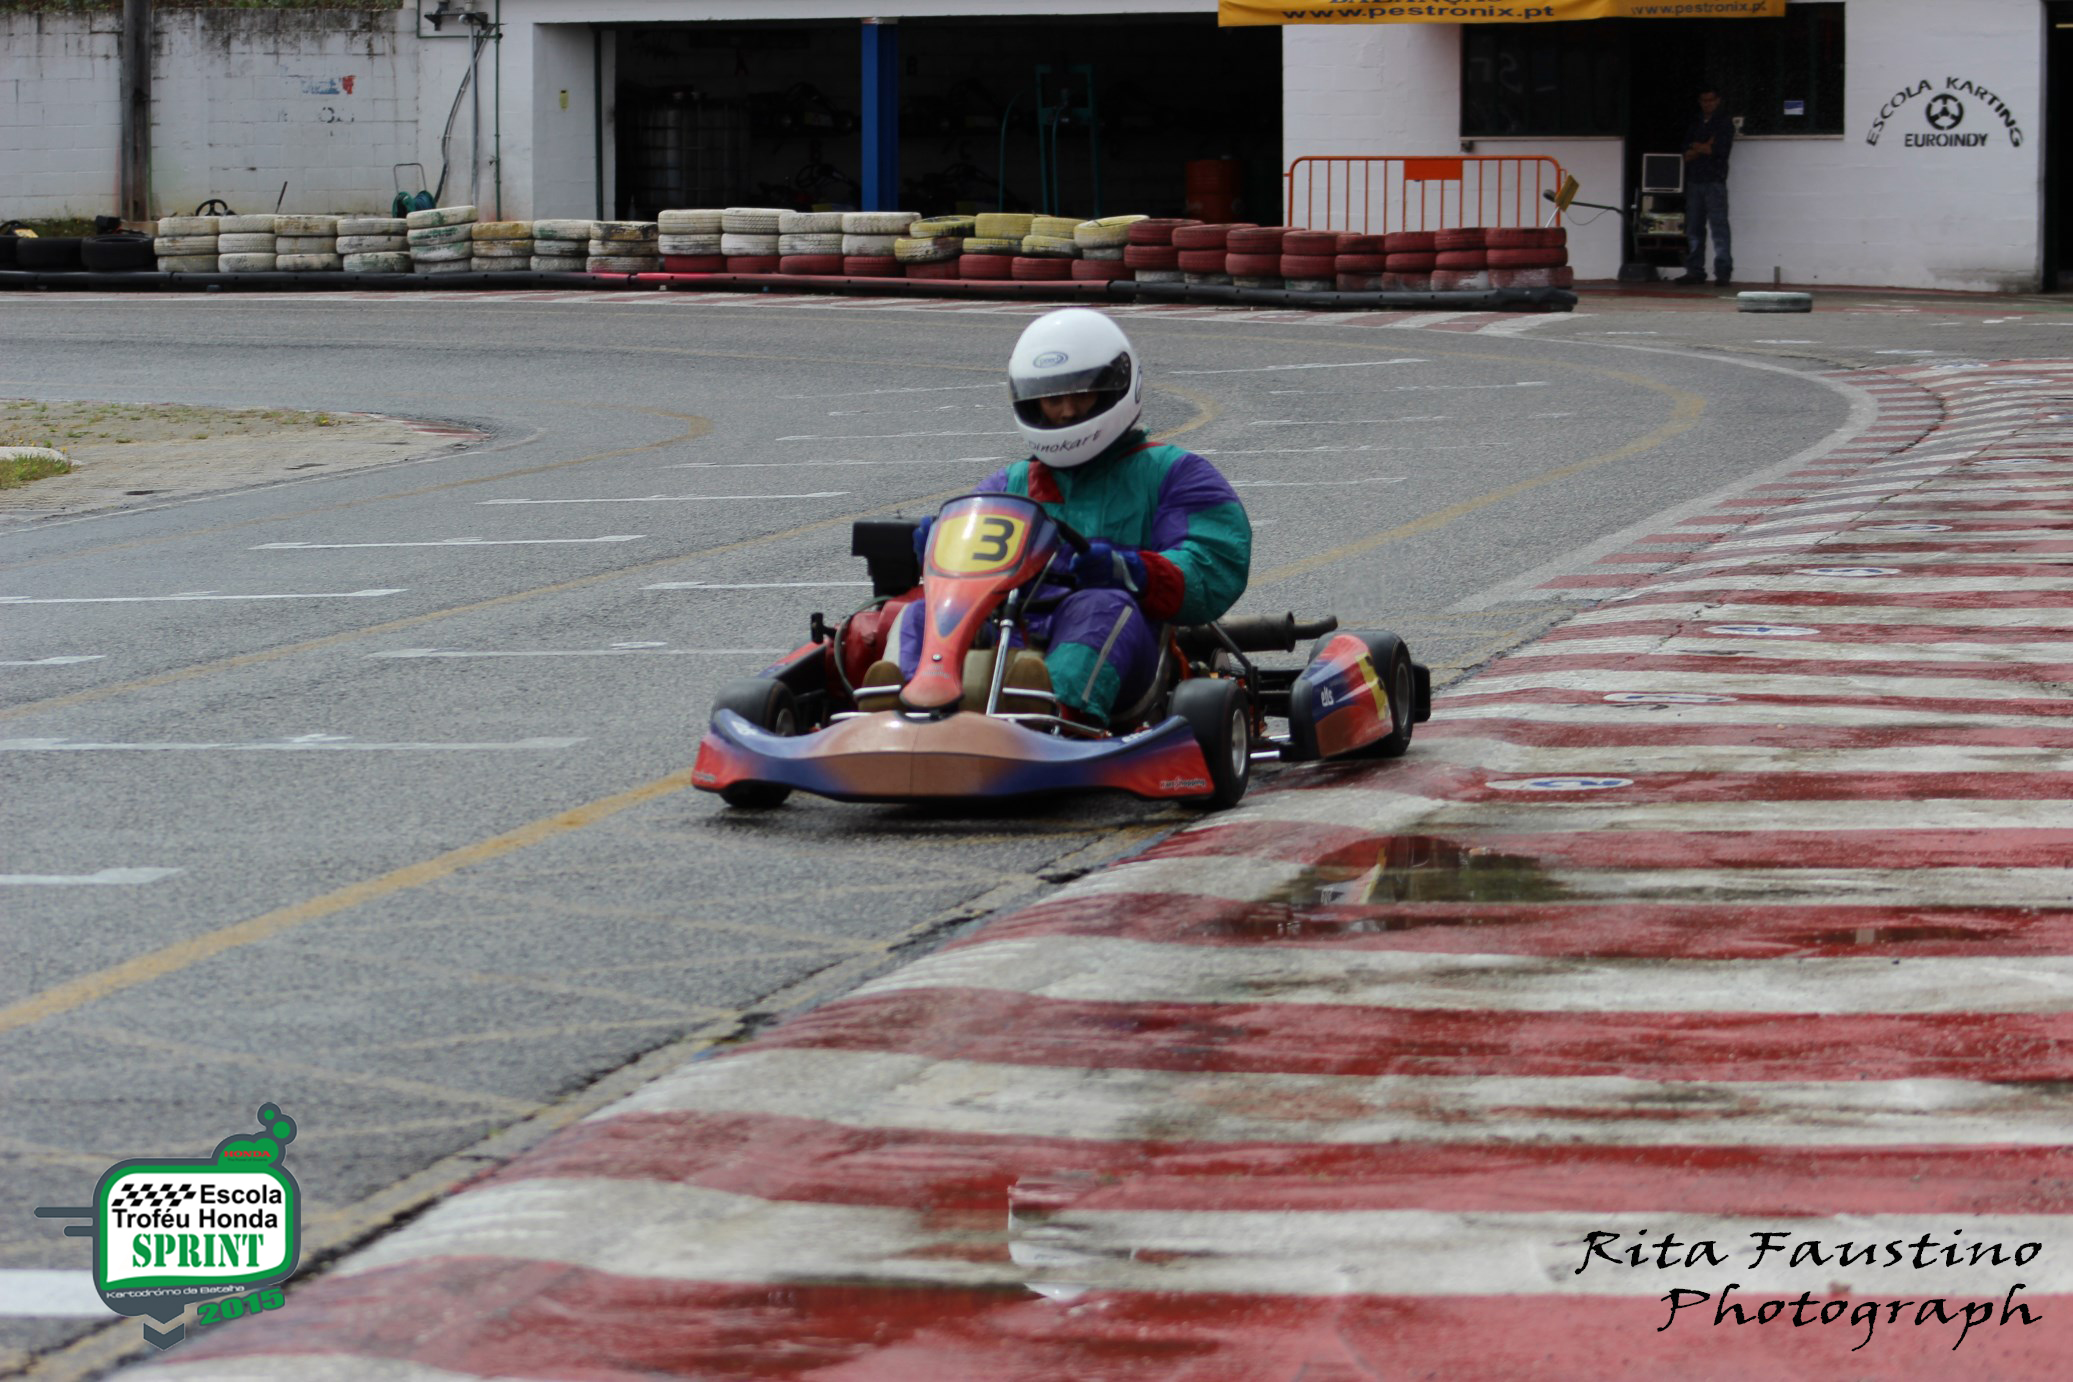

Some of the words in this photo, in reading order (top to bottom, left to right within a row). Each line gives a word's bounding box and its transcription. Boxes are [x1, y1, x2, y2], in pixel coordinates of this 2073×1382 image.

[1282, 5, 1555, 19] www.pestronix.pt
[1866, 79, 1932, 146] ESCOLA
[1946, 76, 2024, 148] KARTING
[1904, 133, 1988, 147] EUROINDY
[972, 517, 1015, 562] 3
